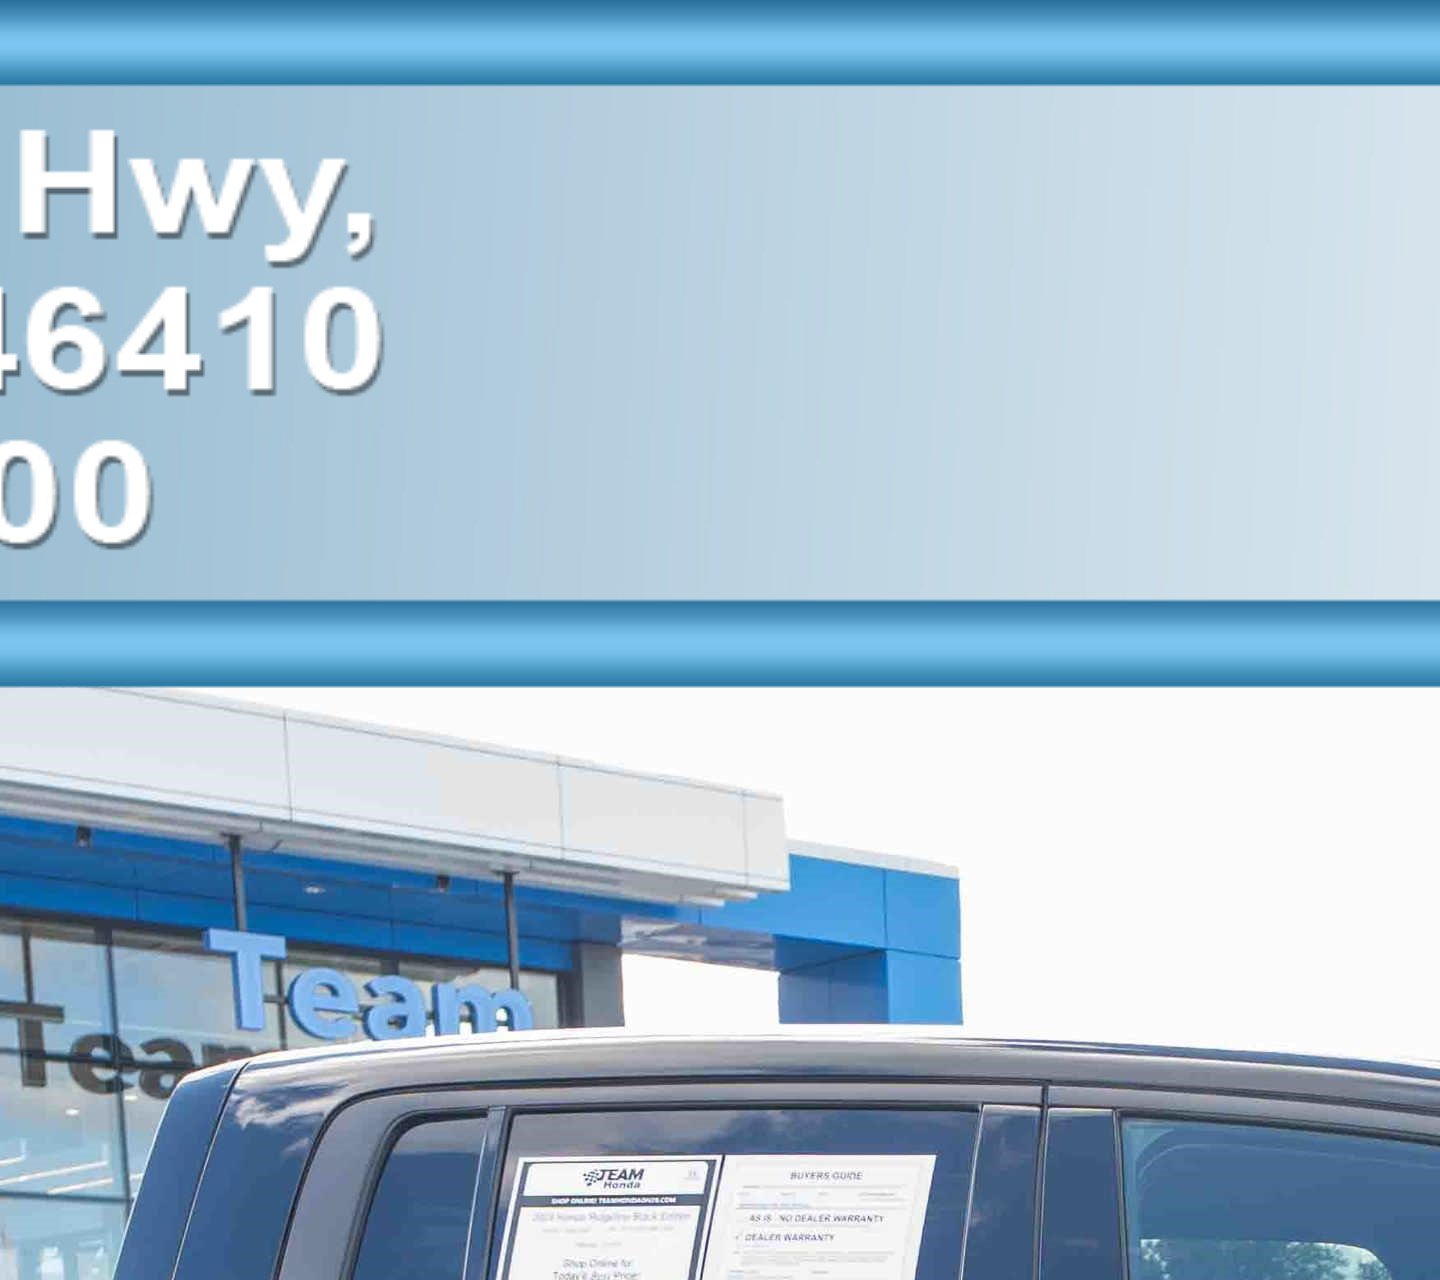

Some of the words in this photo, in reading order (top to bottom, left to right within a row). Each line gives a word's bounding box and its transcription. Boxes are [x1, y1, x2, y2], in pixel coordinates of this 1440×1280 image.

[203, 927, 533, 1041] Team
[598, 1167, 645, 1181] TEAM
[603, 1180, 642, 1190] Honda
[794, 1213, 831, 1224] DEALER
[832, 1213, 885, 1224] WARRANTY
[744, 1232, 781, 1243] DEALER
[783, 1232, 835, 1242] WARRANTY
